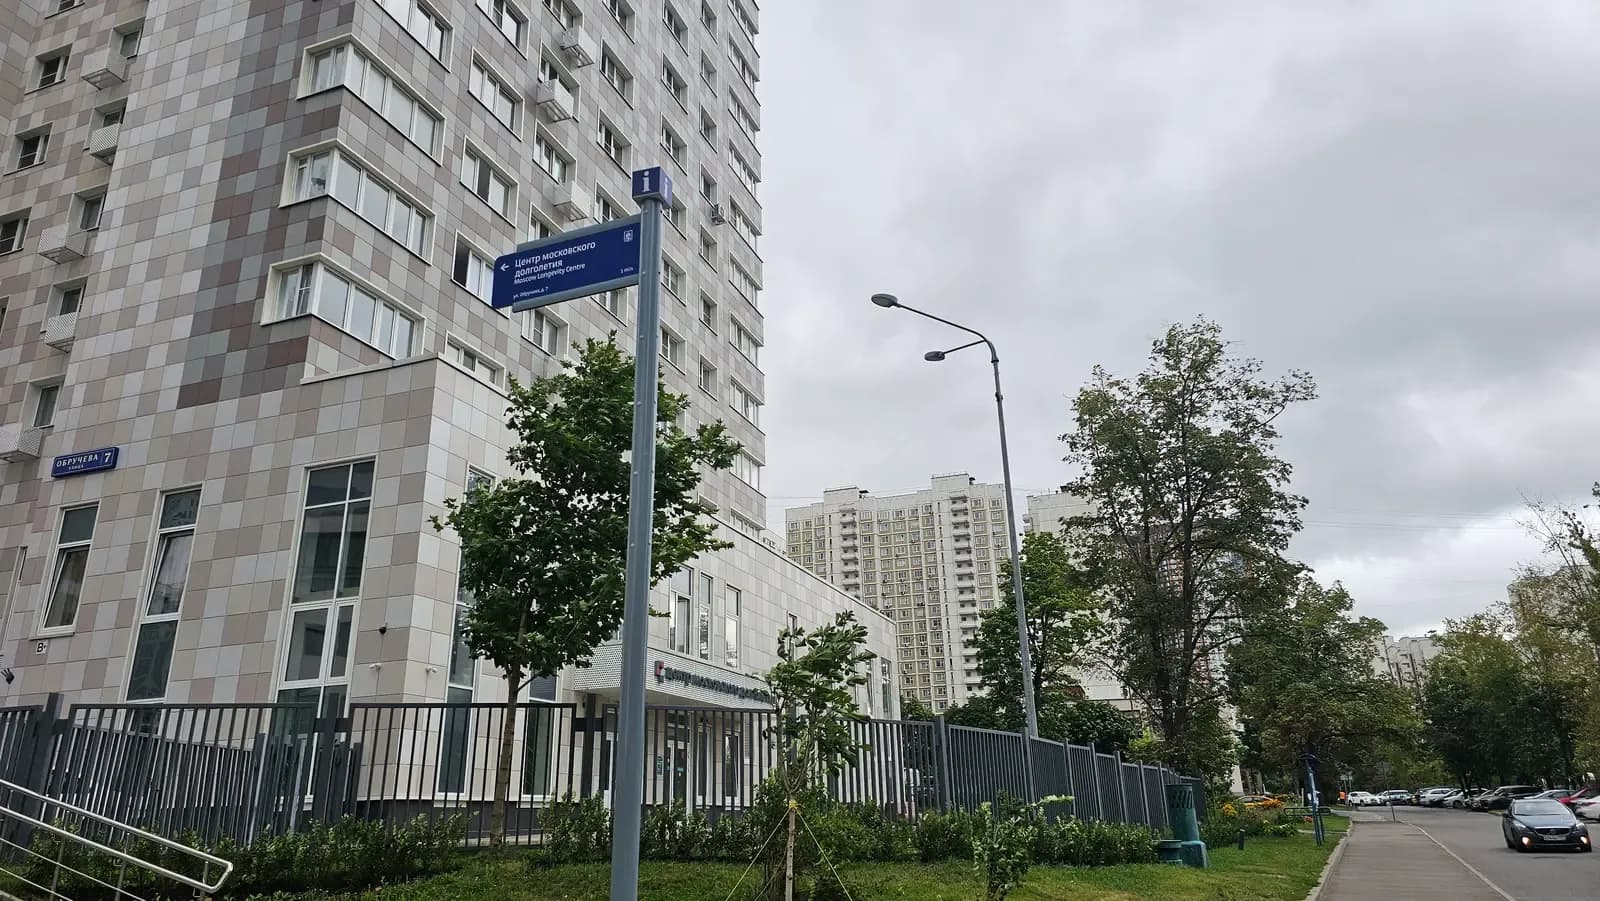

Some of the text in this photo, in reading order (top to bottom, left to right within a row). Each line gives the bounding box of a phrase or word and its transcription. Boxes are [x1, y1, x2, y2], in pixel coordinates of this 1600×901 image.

[515, 242, 596, 268] Центр московского
[514, 260, 563, 278] долголетия
[514, 263, 586, 285] Moscow Longevity Centre
[56, 452, 112, 467] ОБРУЧЕВА 7
